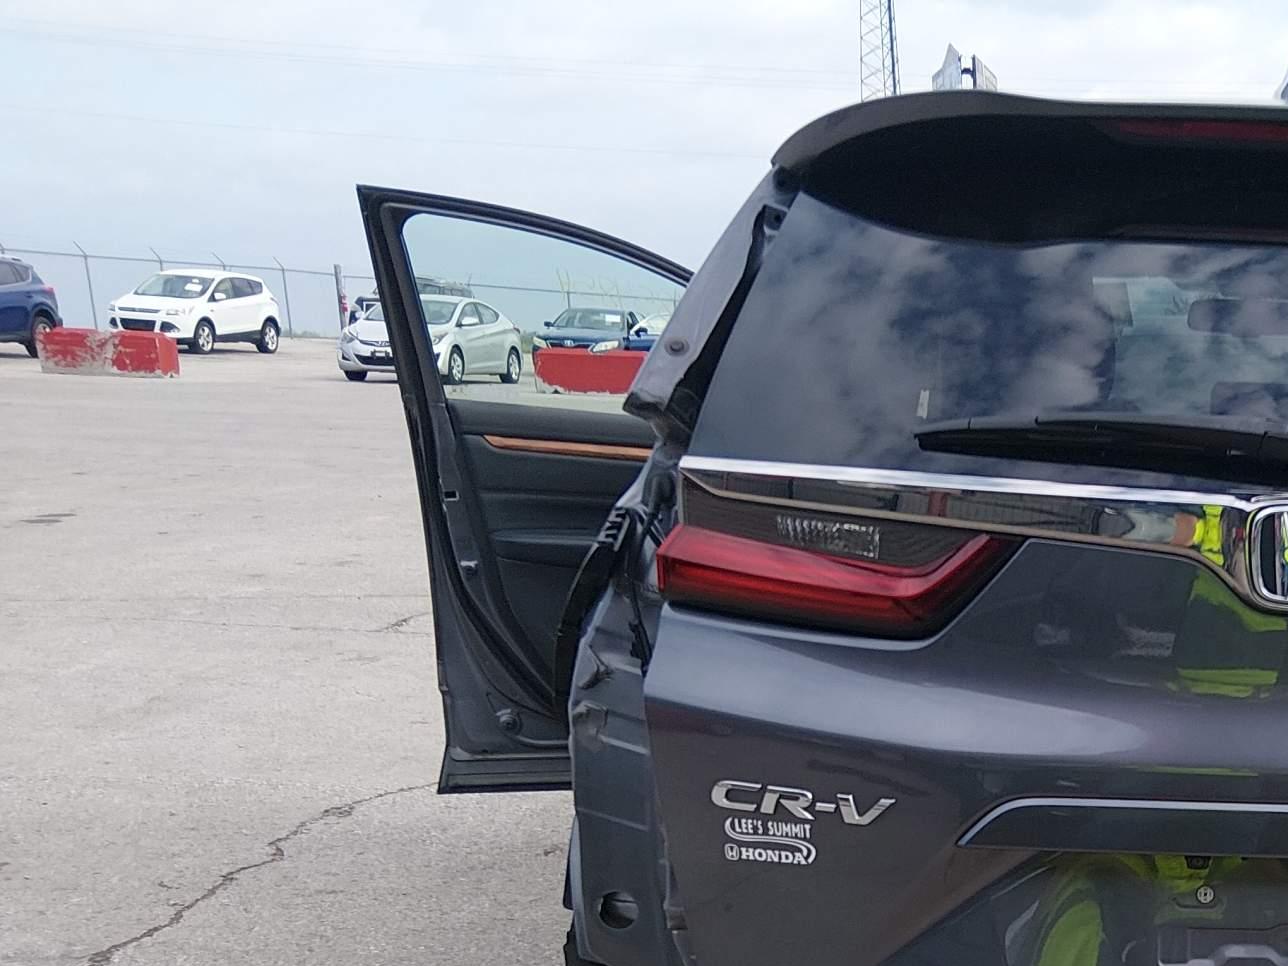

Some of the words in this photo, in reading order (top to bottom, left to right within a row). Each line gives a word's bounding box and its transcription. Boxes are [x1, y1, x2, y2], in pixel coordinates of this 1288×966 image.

[711, 780, 896, 825] CR-V
[734, 817, 763, 835] LEE'S
[767, 821, 811, 839] SUMMIT
[740, 847, 808, 865] HONDA
